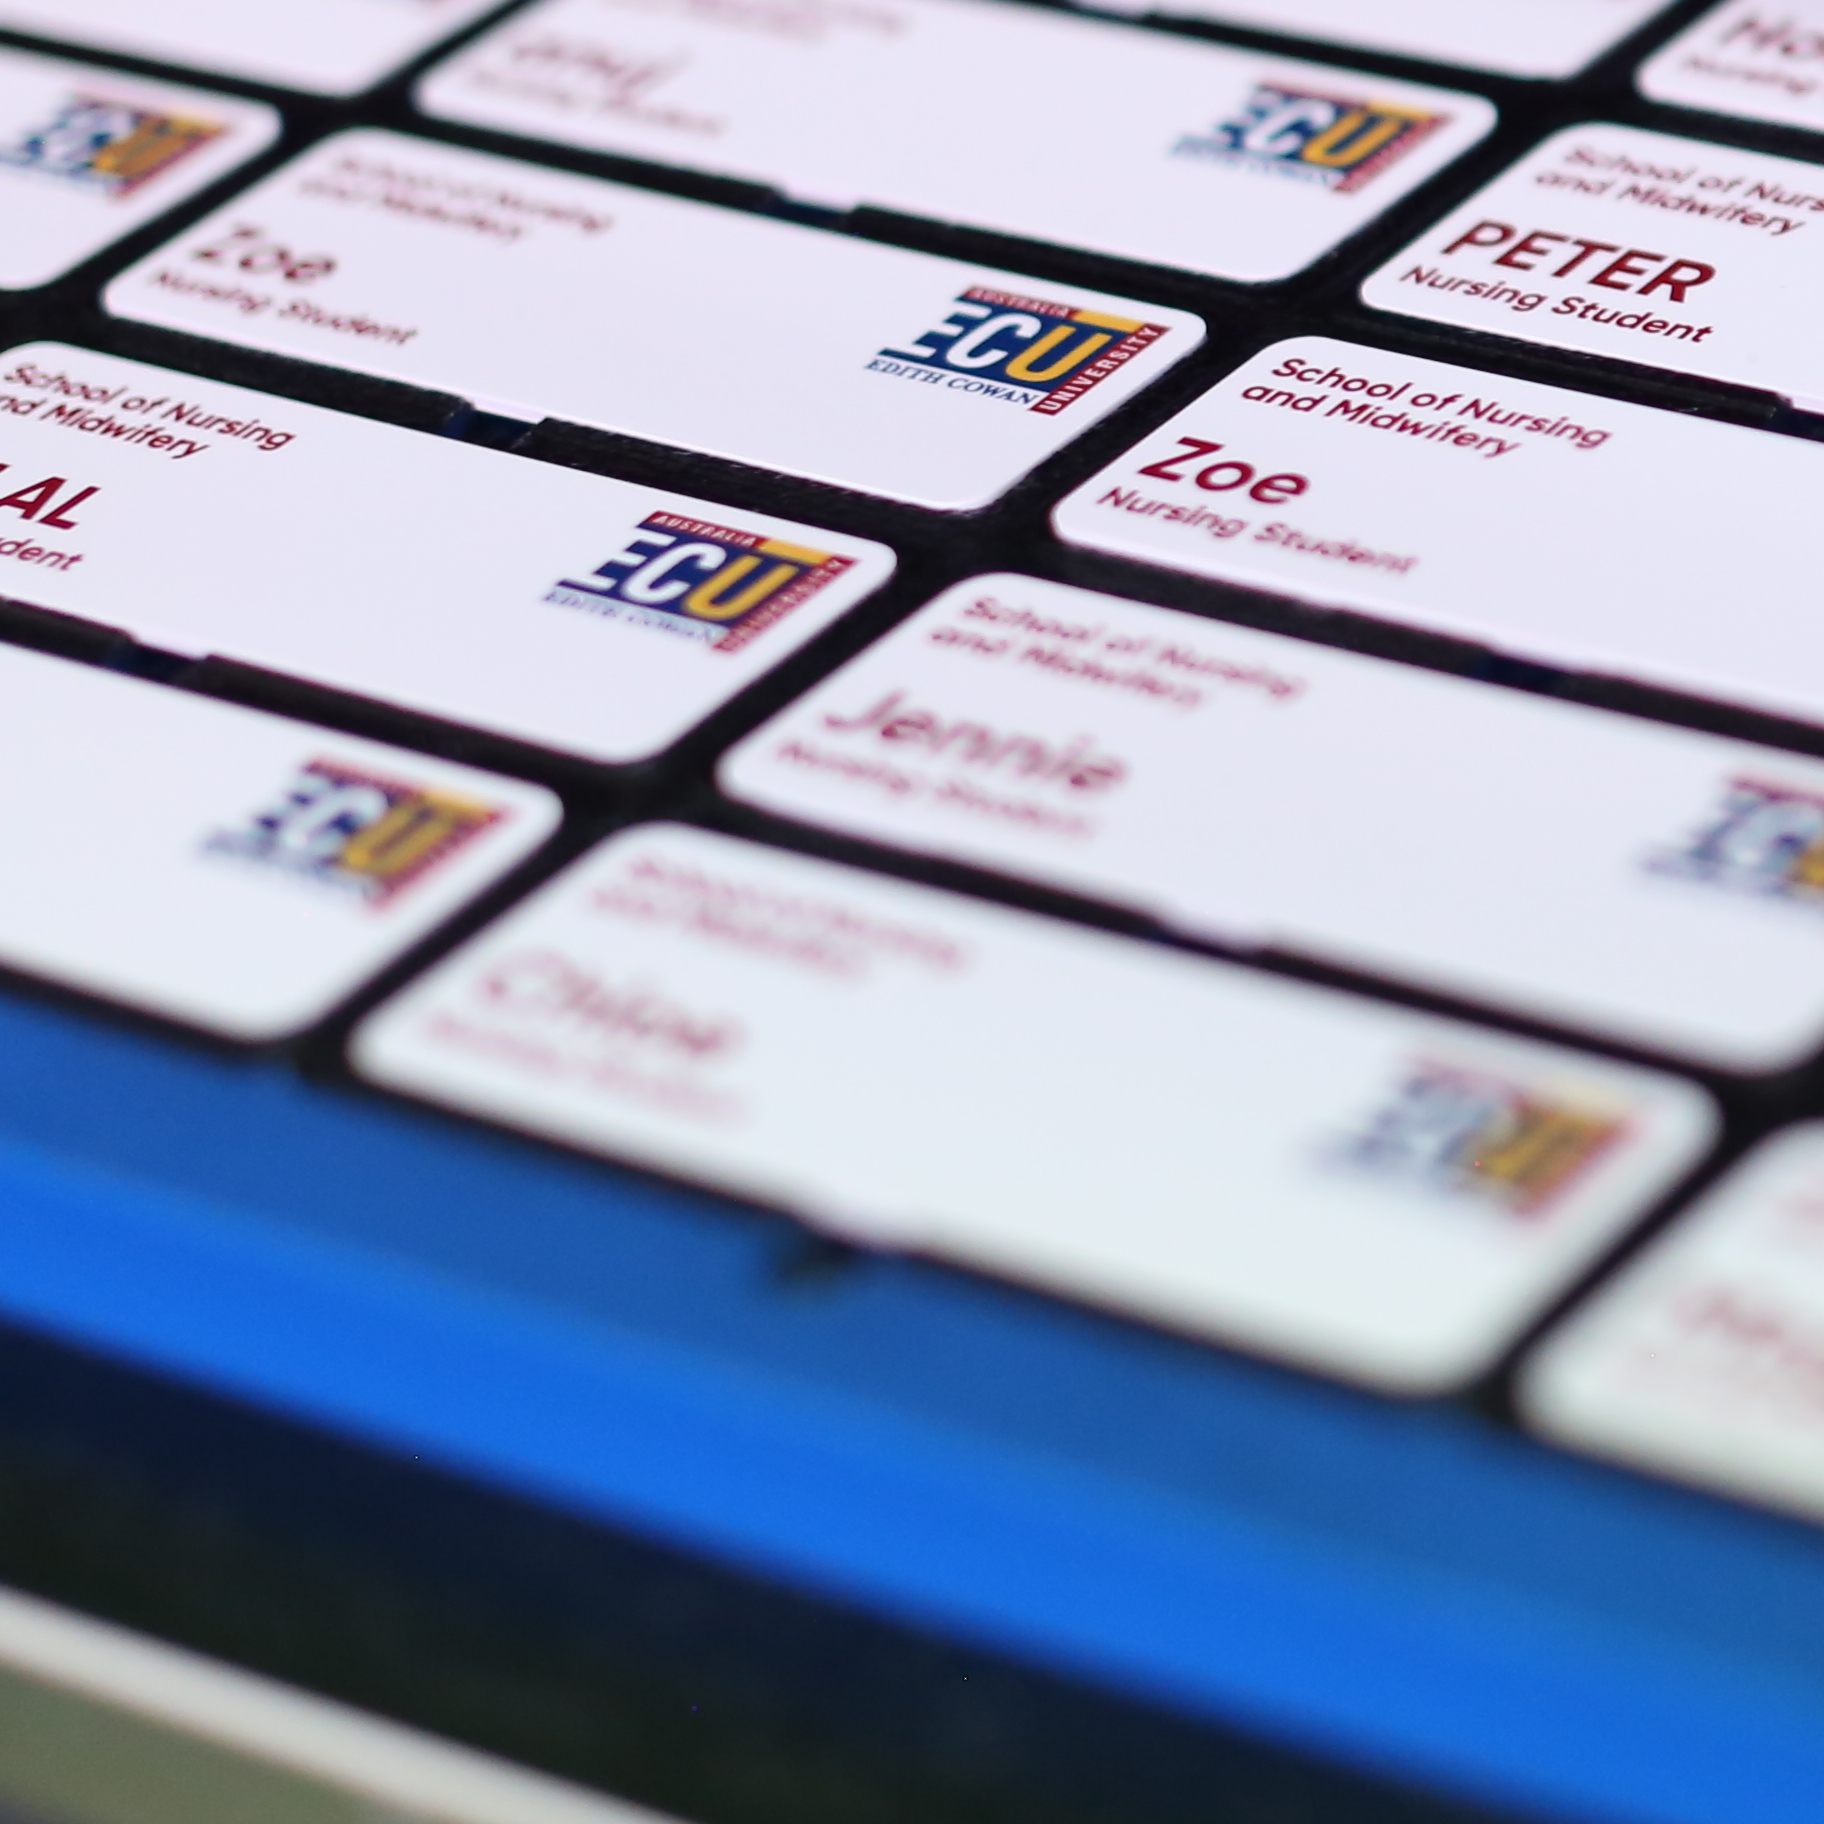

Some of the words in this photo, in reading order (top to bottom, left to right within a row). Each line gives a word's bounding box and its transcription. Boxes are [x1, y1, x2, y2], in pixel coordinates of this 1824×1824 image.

[1534, 168, 1614, 205] and
[1618, 180, 1808, 237] Midwifery
[1562, 144, 1694, 187] School
[1698, 171, 1744, 196] of
[195, 223, 338, 288] Zoe
[1440, 219, 1720, 306] PETER
[149, 266, 272, 318] Nursing
[280, 298, 421, 348] Student
[1399, 263, 1547, 315] Nursing
[1550, 294, 1716, 344] Student
[863, 357, 947, 386] EDITH
[948, 375, 1040, 408] COWAN
[896, 306, 1113, 384] ECU
[1042, 325, 1161, 413] UNIVERSITY
[0, 394, 48, 417] nd
[39, 403, 212, 460] Midwifery
[8, 363, 128, 404] School
[120, 395, 170, 415] of
[159, 402, 298, 452] Nursing
[1239, 383, 1328, 415] and
[1330, 400, 1521, 459] Midwifery
[1271, 356, 1405, 404] School
[1409, 383, 1453, 413] of
[1455, 394, 1612, 451] Nursing
[0, 462, 102, 531] AL
[1137, 437, 1312, 507] Zoe
[651, 513, 758, 546] AUSTRALIA
[1096, 484, 1248, 540] Nursing
[1255, 522, 1421, 575] Student
[568, 527, 799, 621] ECU
[819, 689, 1133, 796] Jennie
